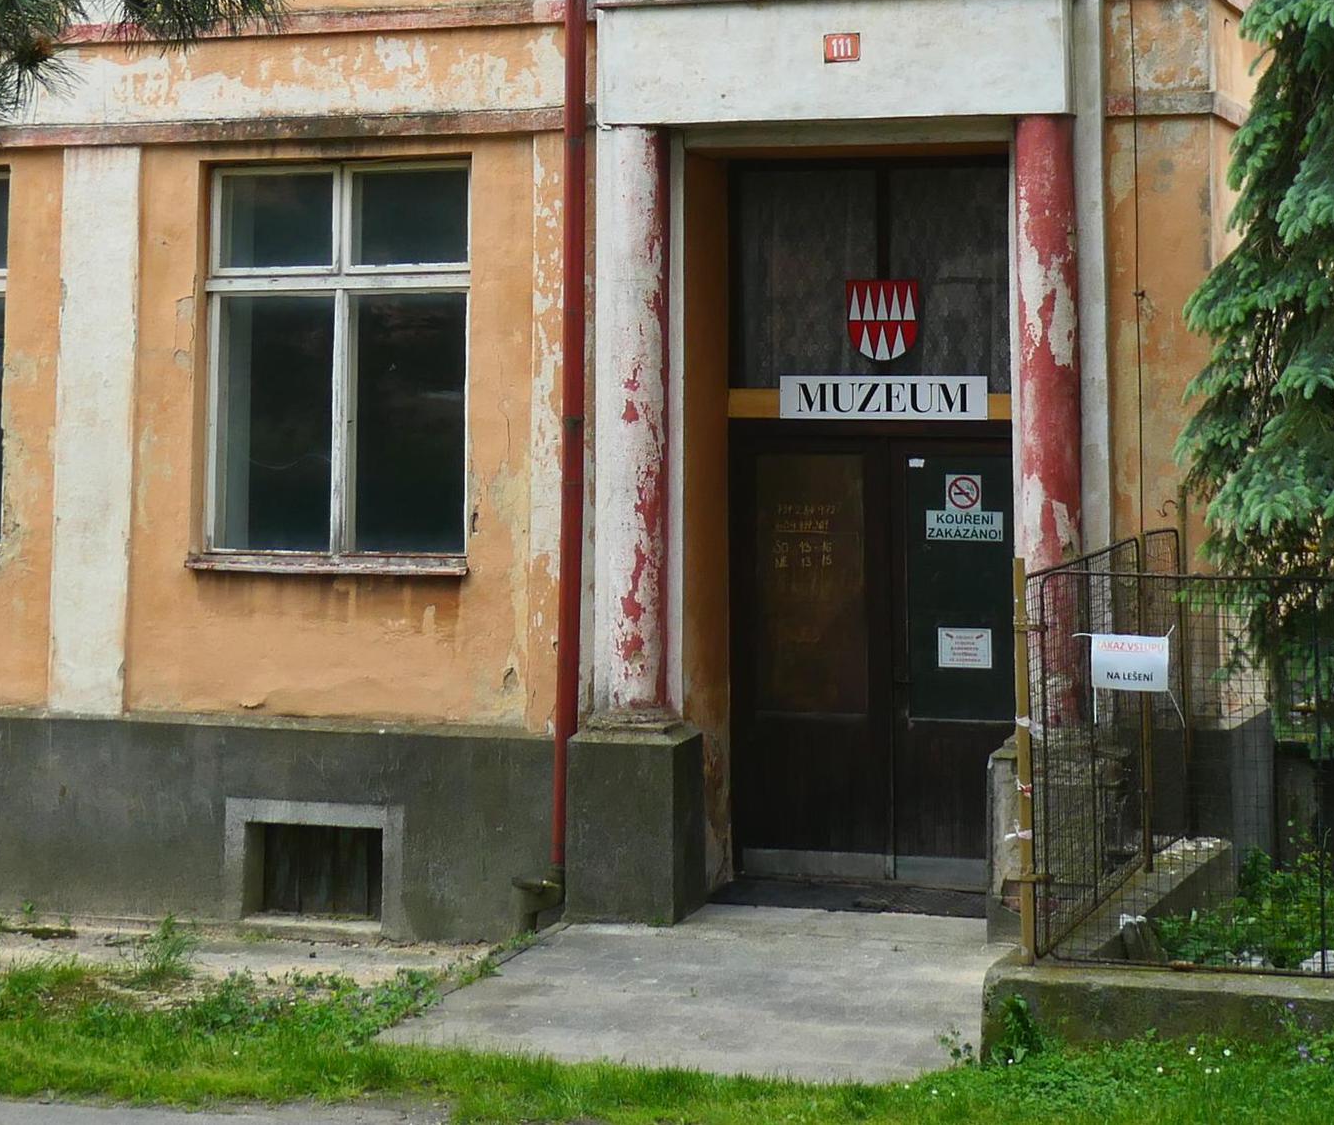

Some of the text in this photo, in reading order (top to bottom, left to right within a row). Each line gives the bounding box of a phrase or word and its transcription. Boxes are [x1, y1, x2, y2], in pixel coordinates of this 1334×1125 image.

[831, 38, 851, 57] 111
[796, 382, 970, 413] MUZEUM
[936, 512, 994, 525] KOUŘENÍ
[927, 526, 1002, 540] ZAKÁZÁNO!
[1107, 671, 1154, 682] NA LEŠENÍ
